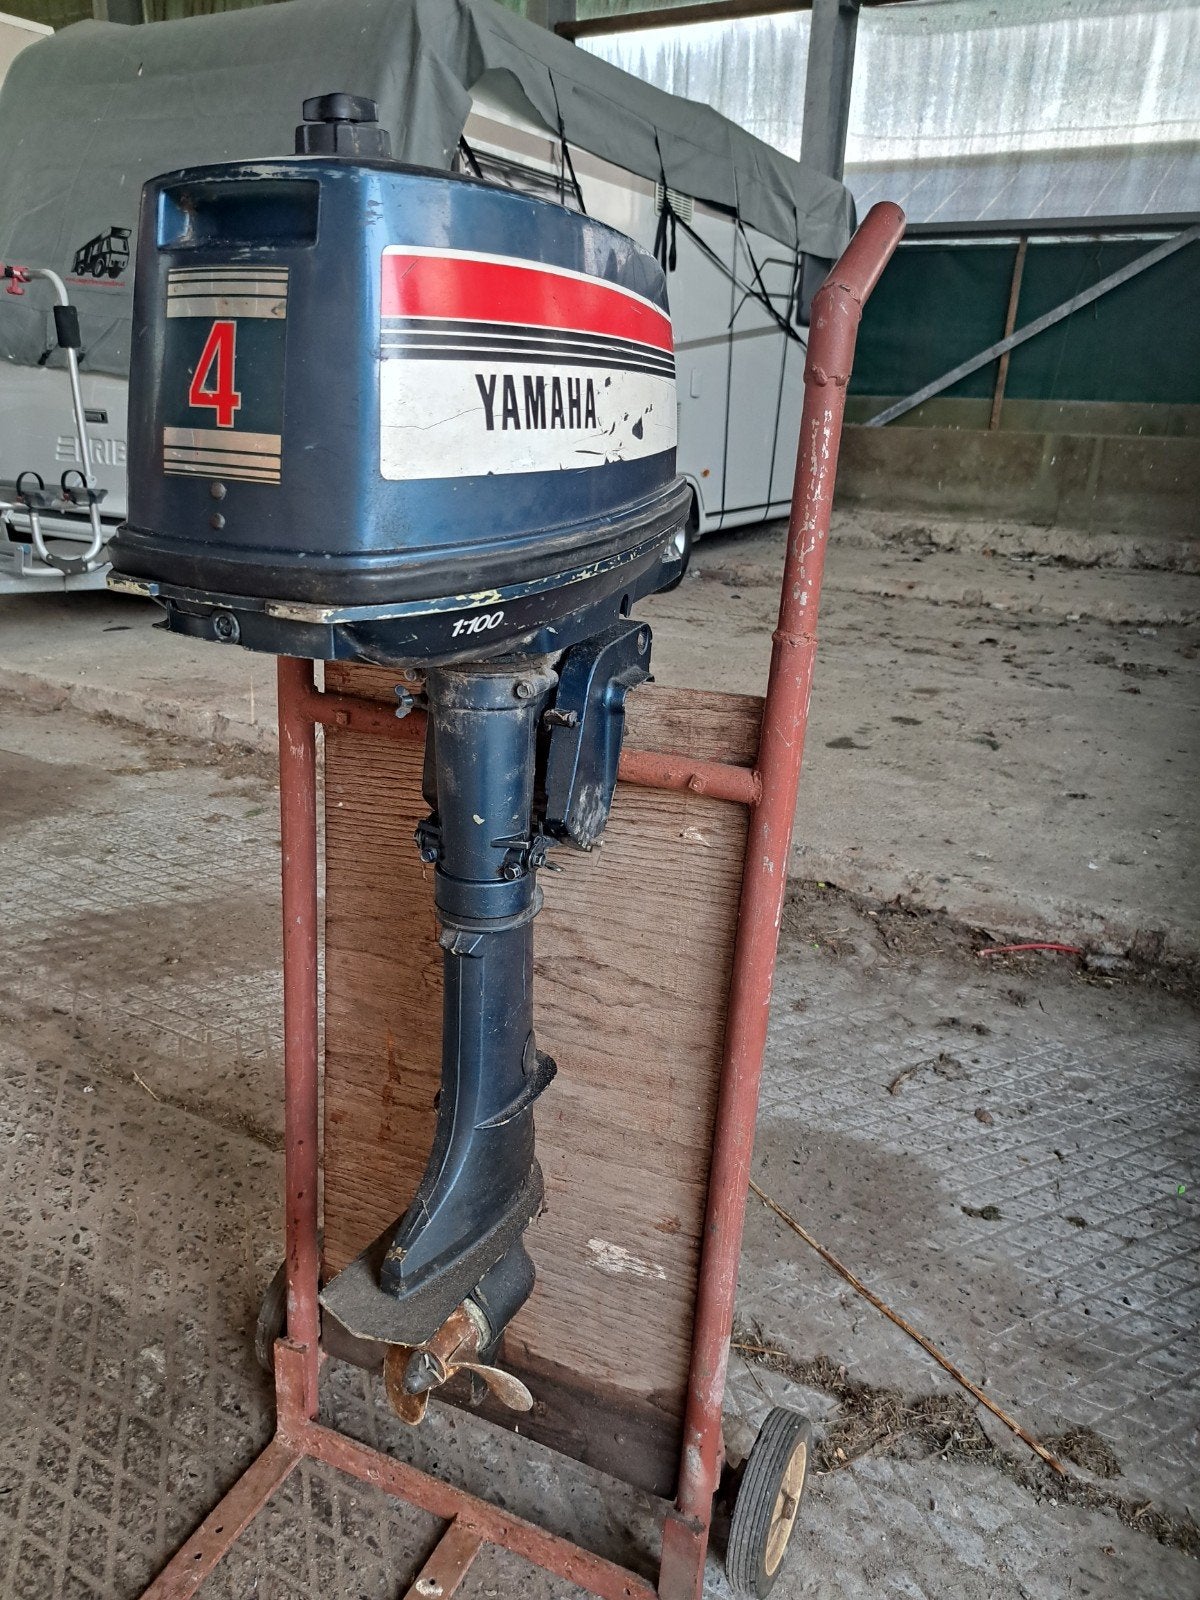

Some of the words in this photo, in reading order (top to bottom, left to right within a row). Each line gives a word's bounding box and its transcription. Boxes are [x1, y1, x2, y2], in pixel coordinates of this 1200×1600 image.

[189, 320, 241, 428] 4
[475, 374, 597, 431] YAMAHA
[451, 610, 505, 638] 1:100
